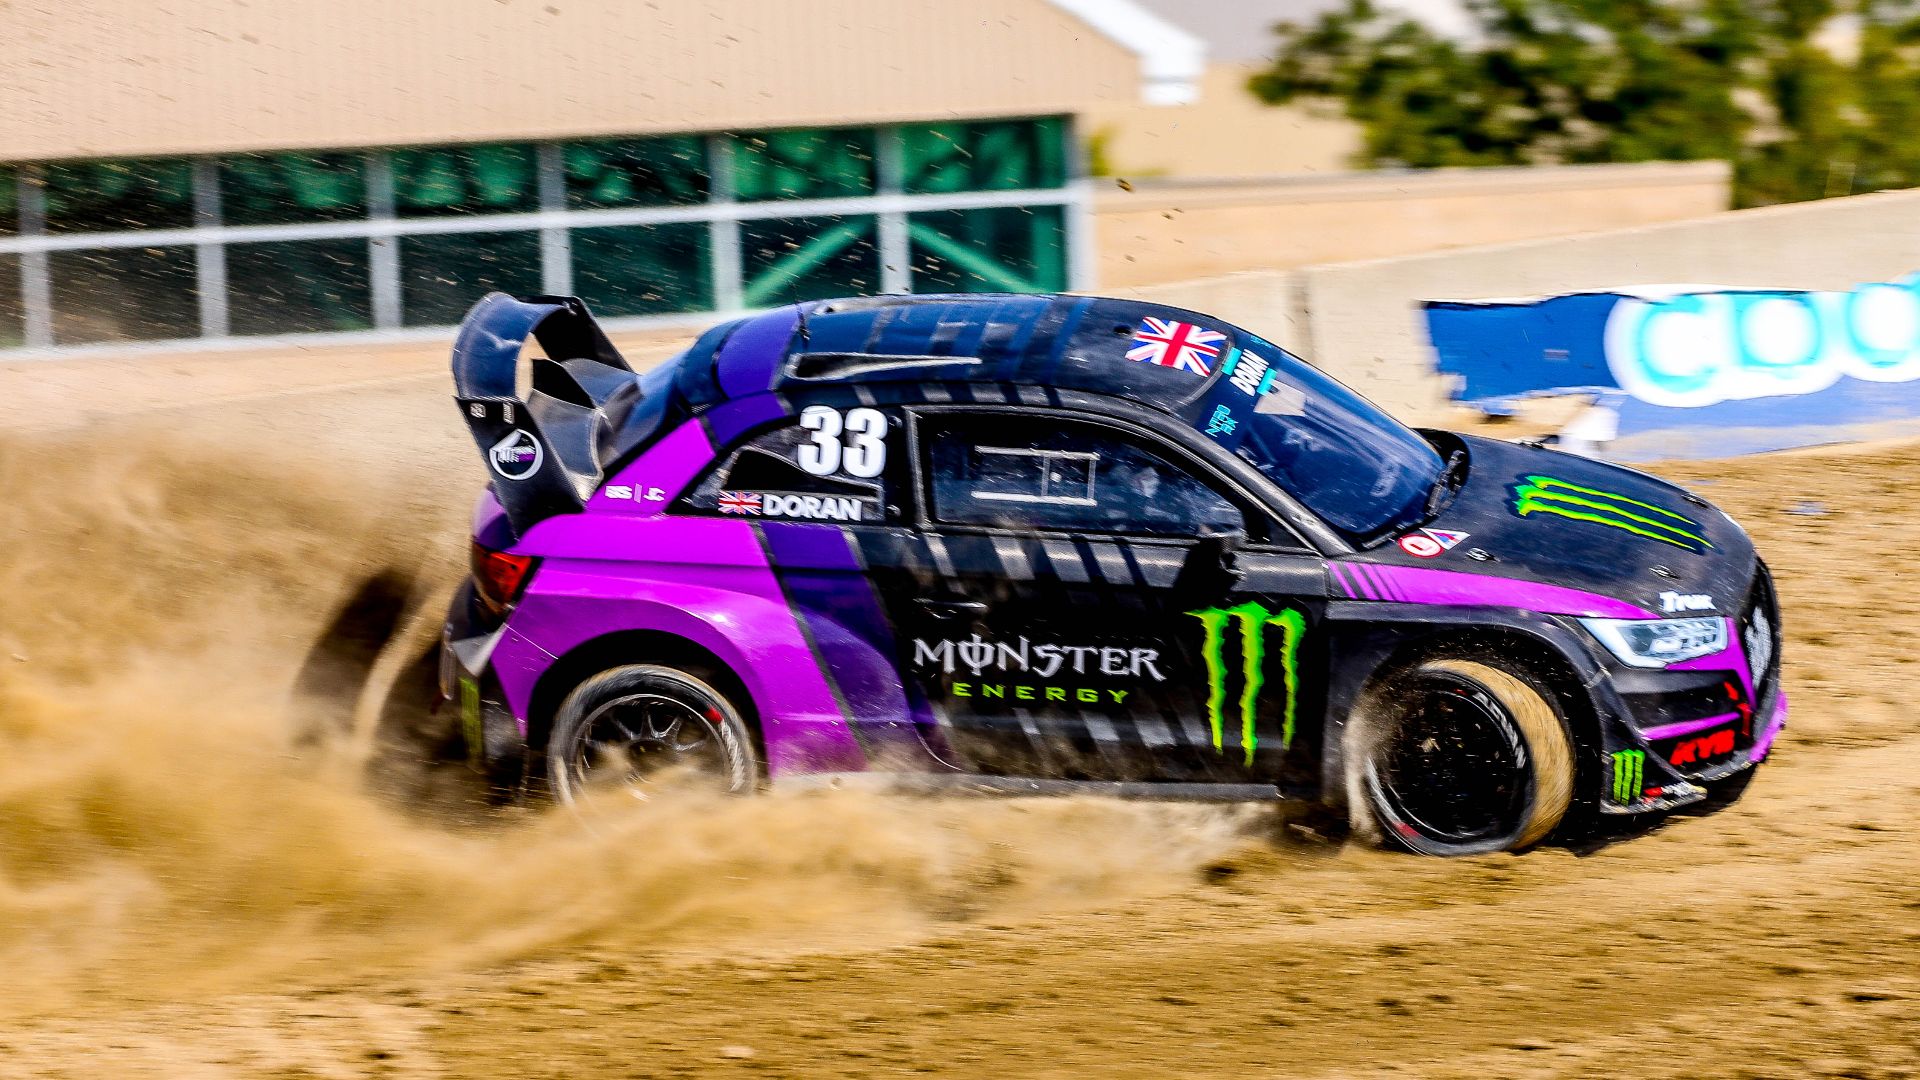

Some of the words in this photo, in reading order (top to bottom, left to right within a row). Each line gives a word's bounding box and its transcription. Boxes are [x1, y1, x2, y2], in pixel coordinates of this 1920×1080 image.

[1229, 348, 1270, 397] DORAN
[797, 405, 889, 479] 33
[762, 493, 863, 522] DORAN
[913, 632, 1167, 682] MONSTER
[951, 682, 1129, 705] ENERGY
